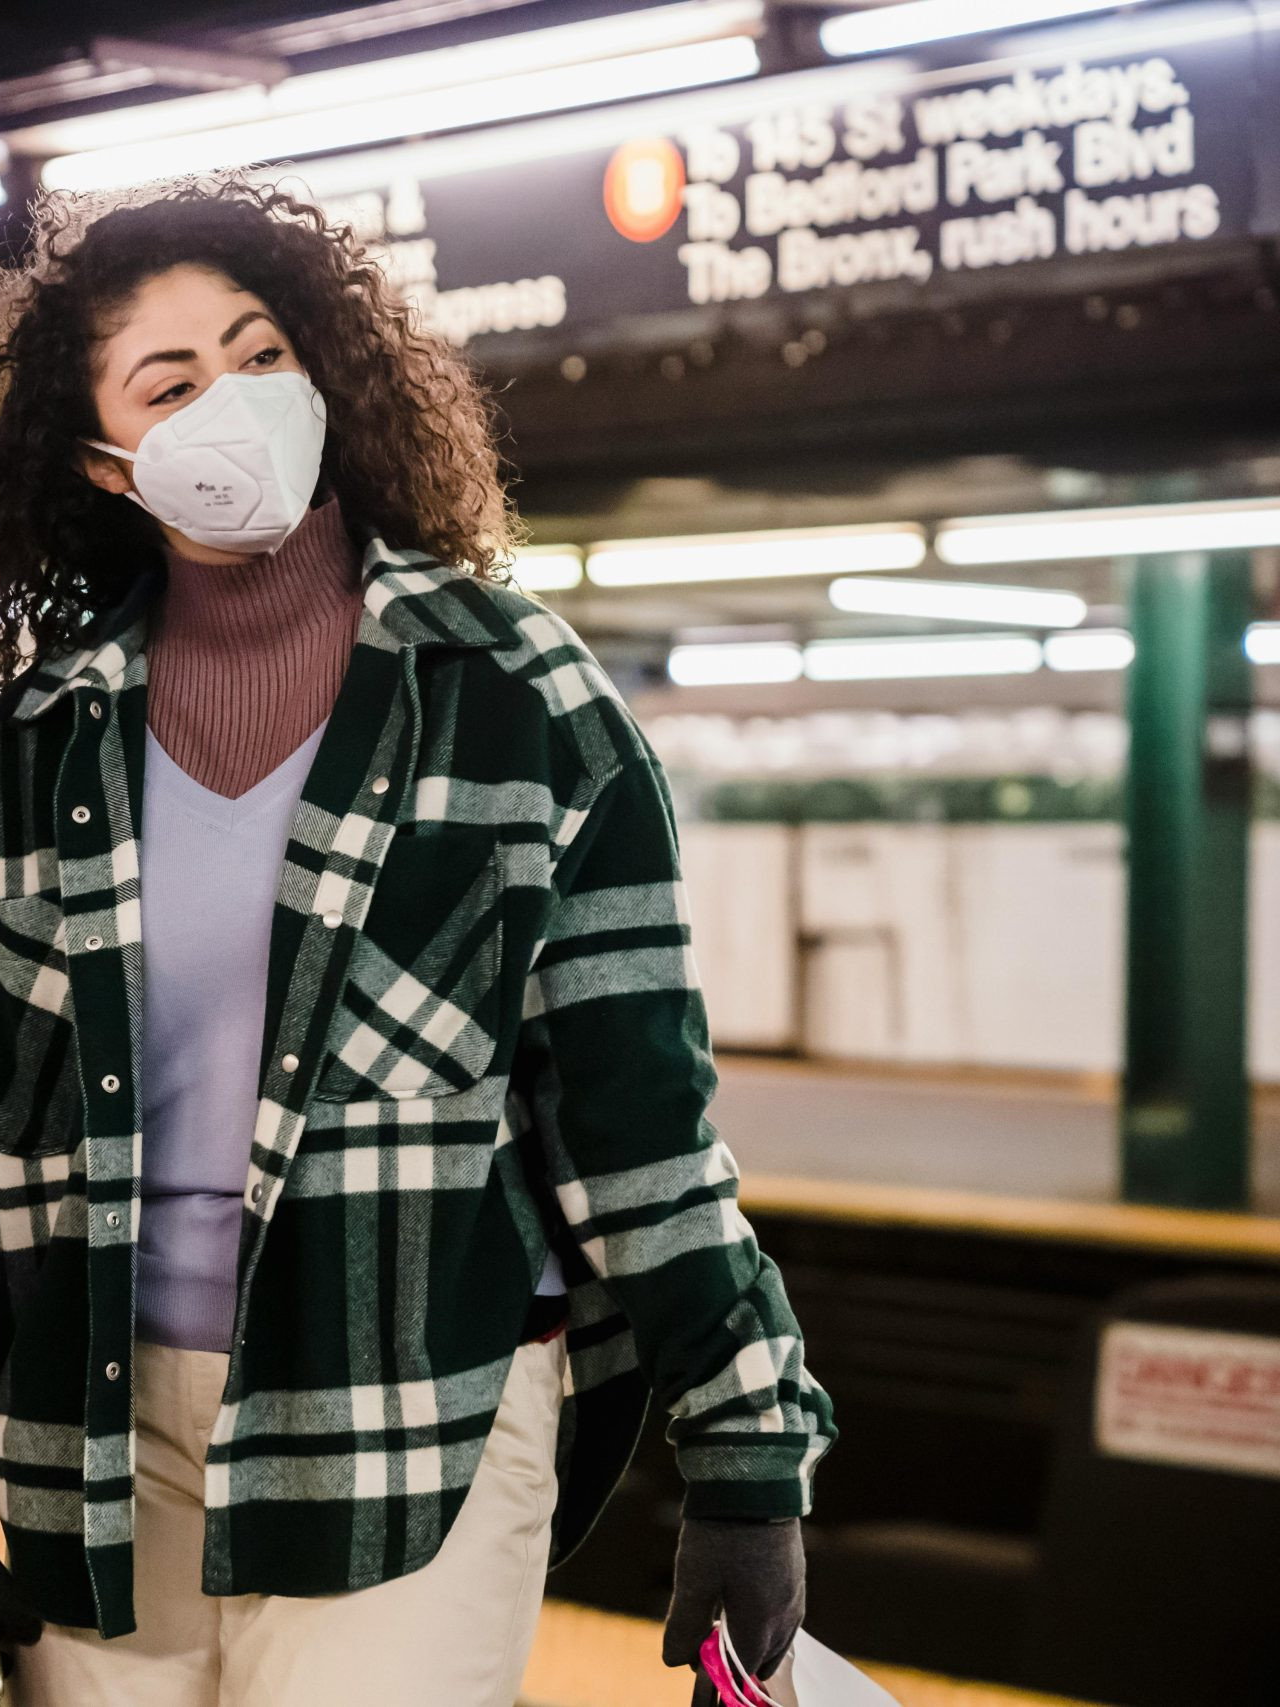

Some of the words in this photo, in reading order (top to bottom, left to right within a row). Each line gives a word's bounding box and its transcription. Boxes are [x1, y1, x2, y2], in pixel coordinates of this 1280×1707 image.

[677, 181, 741, 242] To
[745, 147, 938, 237] Bedford
[946, 131, 1064, 206] Park
[1074, 107, 1195, 187] Blvd
[677, 241, 772, 304] The
[778, 226, 933, 291] Bronx,
[940, 196, 1057, 271] rush
[1064, 184, 1220, 254] hours
